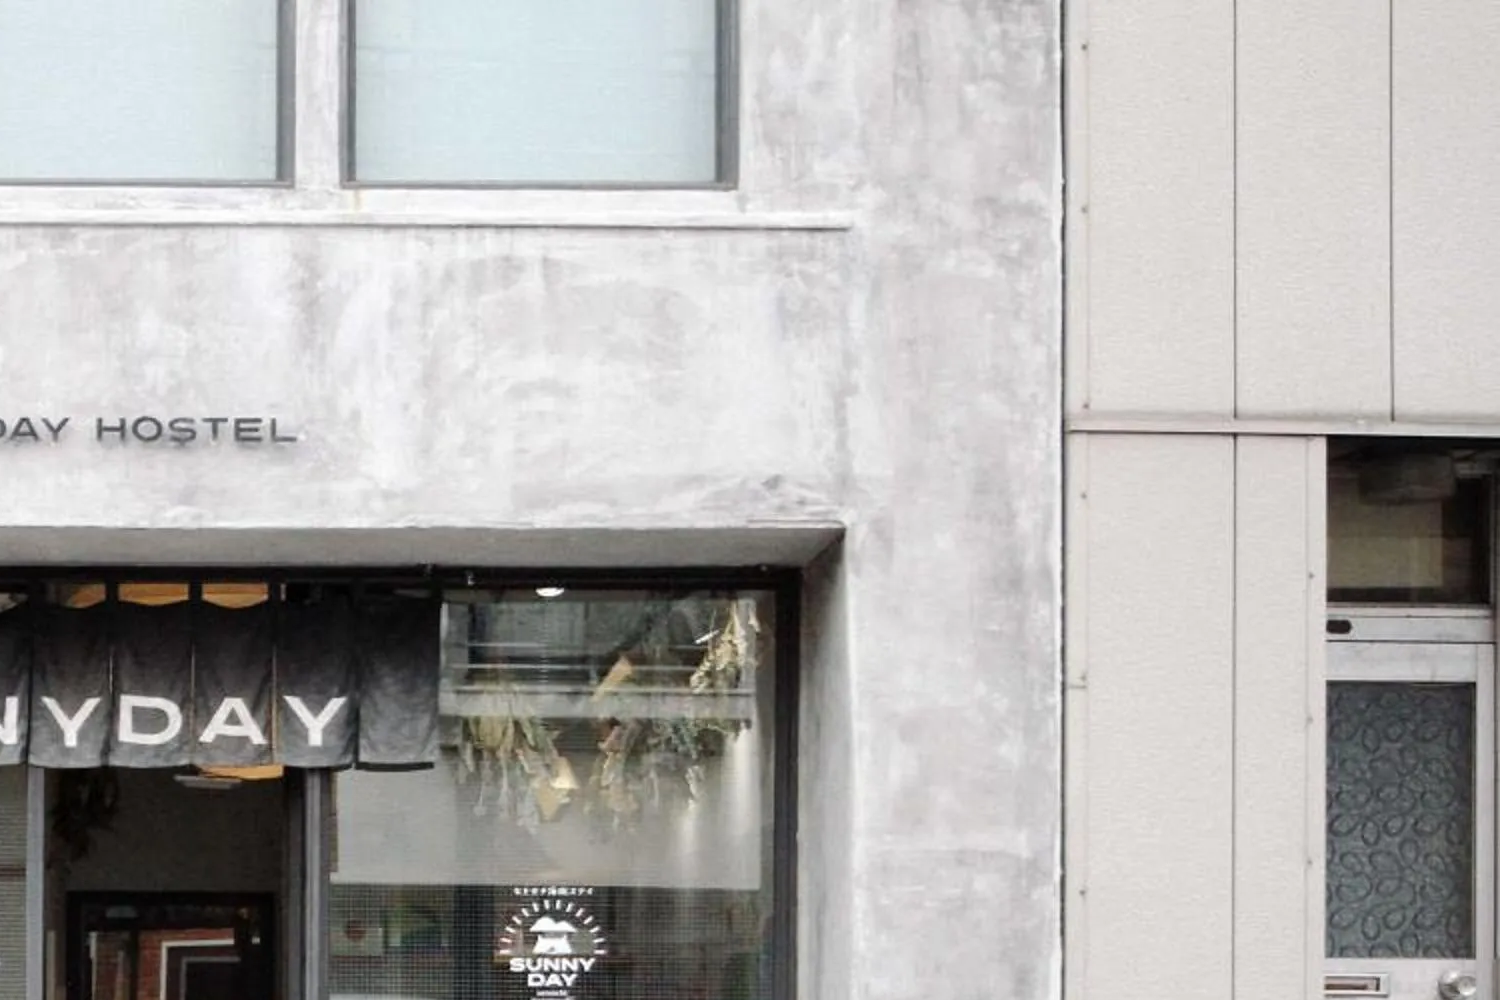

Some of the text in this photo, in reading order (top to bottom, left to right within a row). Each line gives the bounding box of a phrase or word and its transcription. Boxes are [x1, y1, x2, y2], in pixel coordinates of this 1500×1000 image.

[95, 416, 299, 445] HOSTEL
[509, 957, 596, 972] SUNNY
[527, 973, 578, 987] DAY
